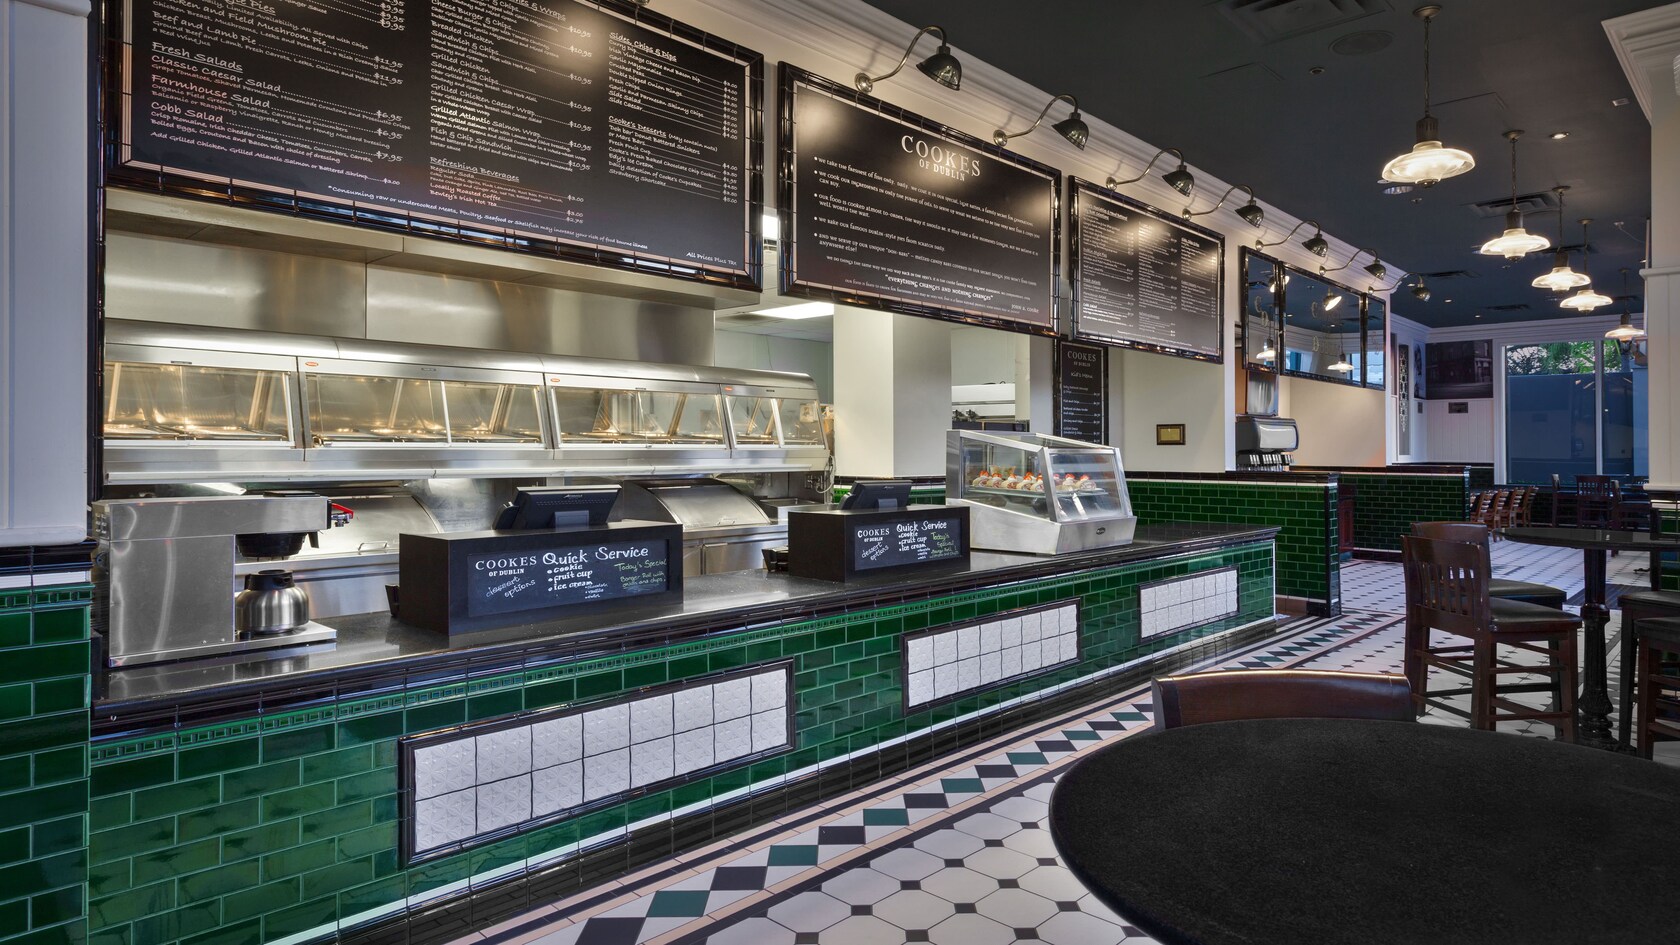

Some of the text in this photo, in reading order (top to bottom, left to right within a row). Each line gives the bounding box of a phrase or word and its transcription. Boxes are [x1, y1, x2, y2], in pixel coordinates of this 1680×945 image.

[250, 0, 275, 14] Pies
[203, 6, 403, 68] and Field Mushroom Pie $11.95
[431, 20, 494, 45] Breaded Chicken
[457, 7, 484, 20] Burger
[492, 19, 512, 33] Chips
[569, 45, 592, 57] $10.95
[152, 10, 403, 84] Beef and Lamb Pie $11.95
[152, 41, 243, 73] Fresh Salads
[431, 30, 470, 46] Sandwich
[479, 44, 499, 57] Chips
[569, 73, 592, 84] $10.95
[609, 32, 633, 48] Sides,
[633, 40, 654, 54] Chips
[661, 50, 677, 62] Dips
[431, 52, 490, 73] Grilled Chicken
[152, 55, 402, 121] Classic Caesar Salad $6.95
[431, 61, 470, 76] Sandwich
[479, 74, 499, 85] Chips
[569, 101, 592, 112] $10.95
[152, 74, 402, 139] Farmhouse Salad $6.95
[431, 83, 592, 131] Grilled Chicken Caesar Wrap $10.95
[151, 101, 403, 162] Cobb Salad $7.95
[431, 105, 591, 151] Grilled Atlantic Salmon Wrap $10.95
[608, 115, 637, 129] Cooke's
[637, 124, 666, 138] Desserts
[431, 126, 447, 135] Fish
[457, 133, 474, 143] Chip
[475, 138, 512, 151] Sandwich
[568, 160, 590, 170] $10.95
[901, 135, 980, 176] COOKES
[430, 156, 519, 183] Refreshing Beverages
[430, 165, 457, 174] Regular
[919, 159, 965, 181] OF DUBLIN
[430, 182, 455, 194] Locally
[456, 188, 481, 196] Roasted
[1068, 350, 1096, 362] COOKES
[858, 528, 890, 538] COOKES
[896, 520, 947, 532] Quick Service
[475, 556, 537, 570] COOKES
[542, 547, 649, 565] Quick Service
[614, 559, 667, 572] Today's Special
[554, 564, 583, 573] cookie
[554, 570, 593, 583] fruit cup
[486, 576, 520, 597] dessert
[504, 579, 535, 598] options
[554, 580, 593, 591] ice cream
